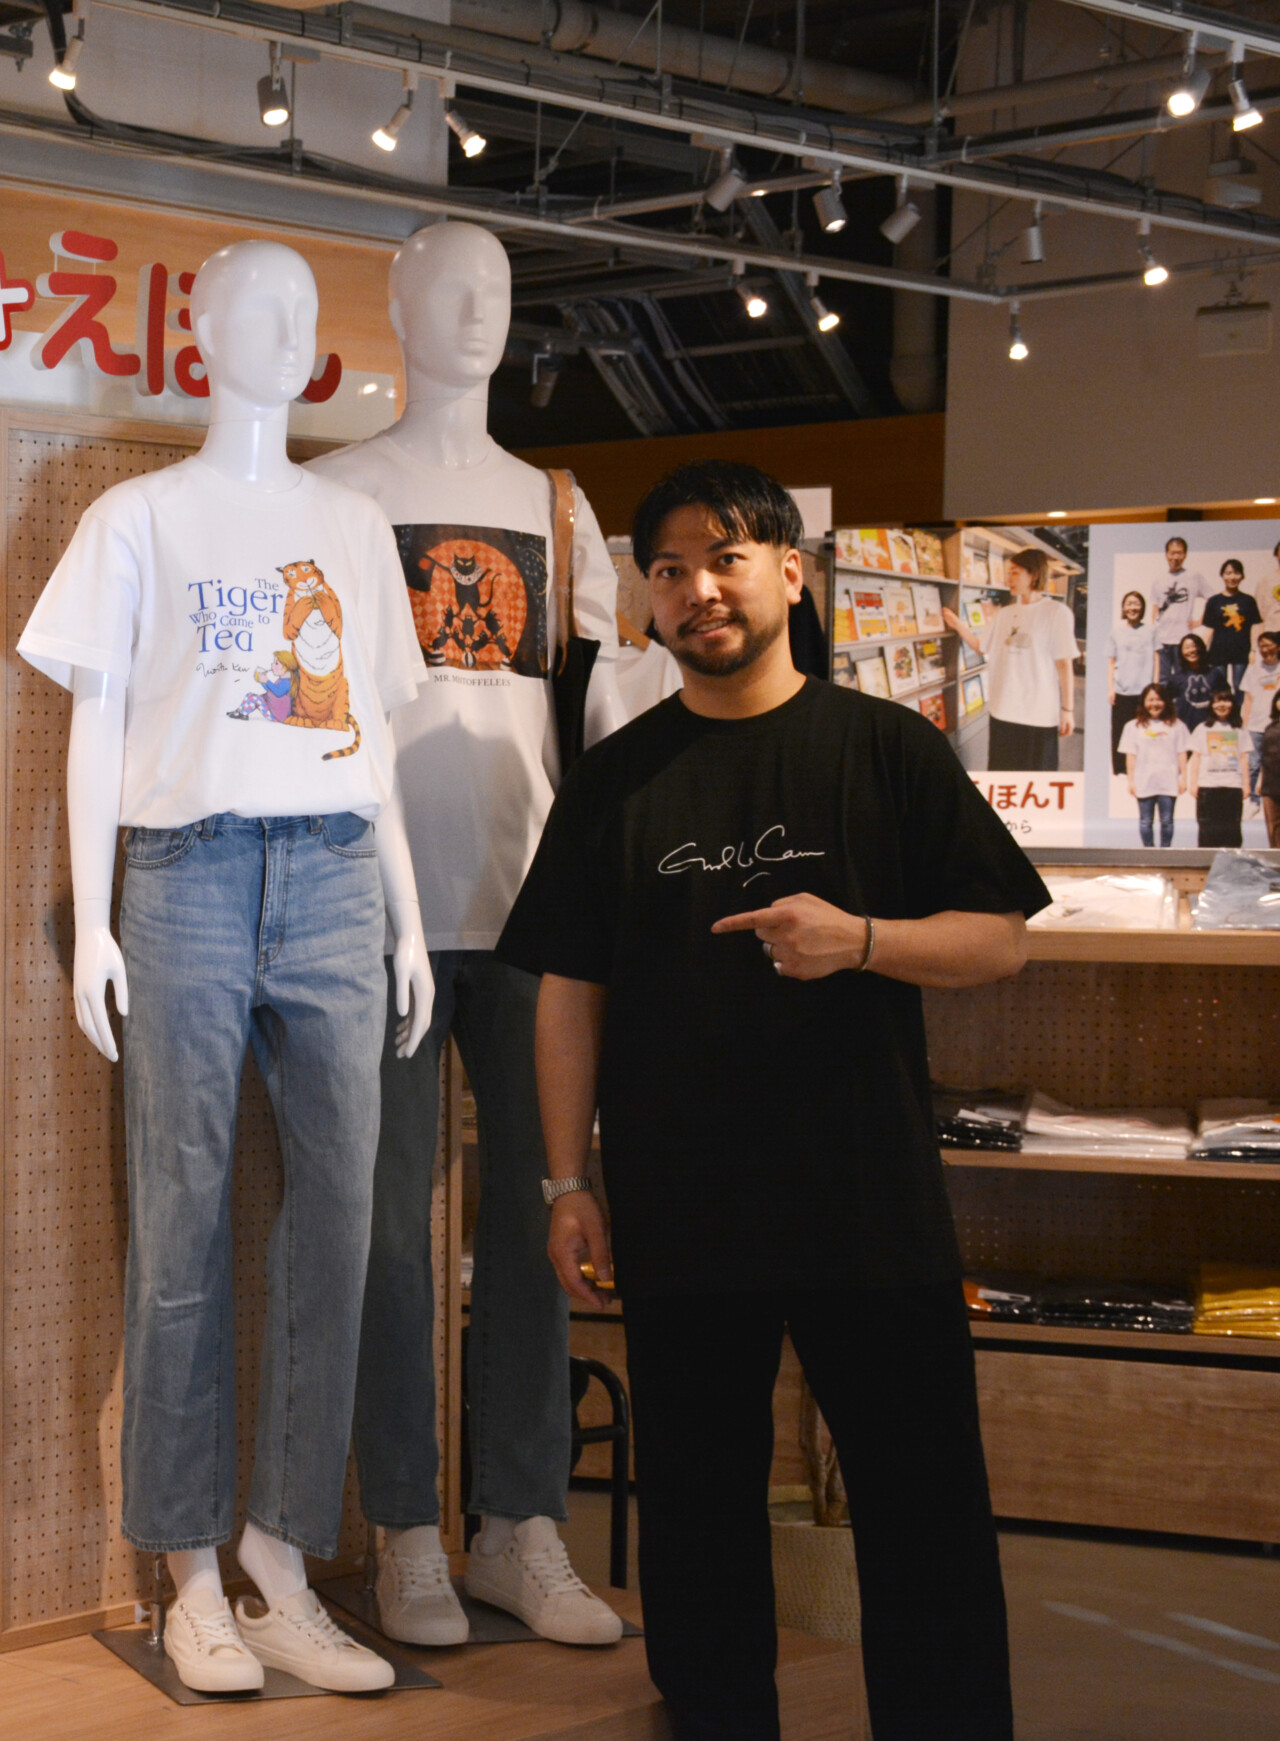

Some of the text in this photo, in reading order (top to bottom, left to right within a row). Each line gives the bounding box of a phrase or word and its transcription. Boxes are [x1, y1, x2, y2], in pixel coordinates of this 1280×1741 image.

[188, 579, 284, 617] Tiger
[255, 577, 279, 591] The
[189, 611, 270, 629] Who Came to
[196, 622, 254, 653] Tea
[972, 780, 1075, 810] ほんT
